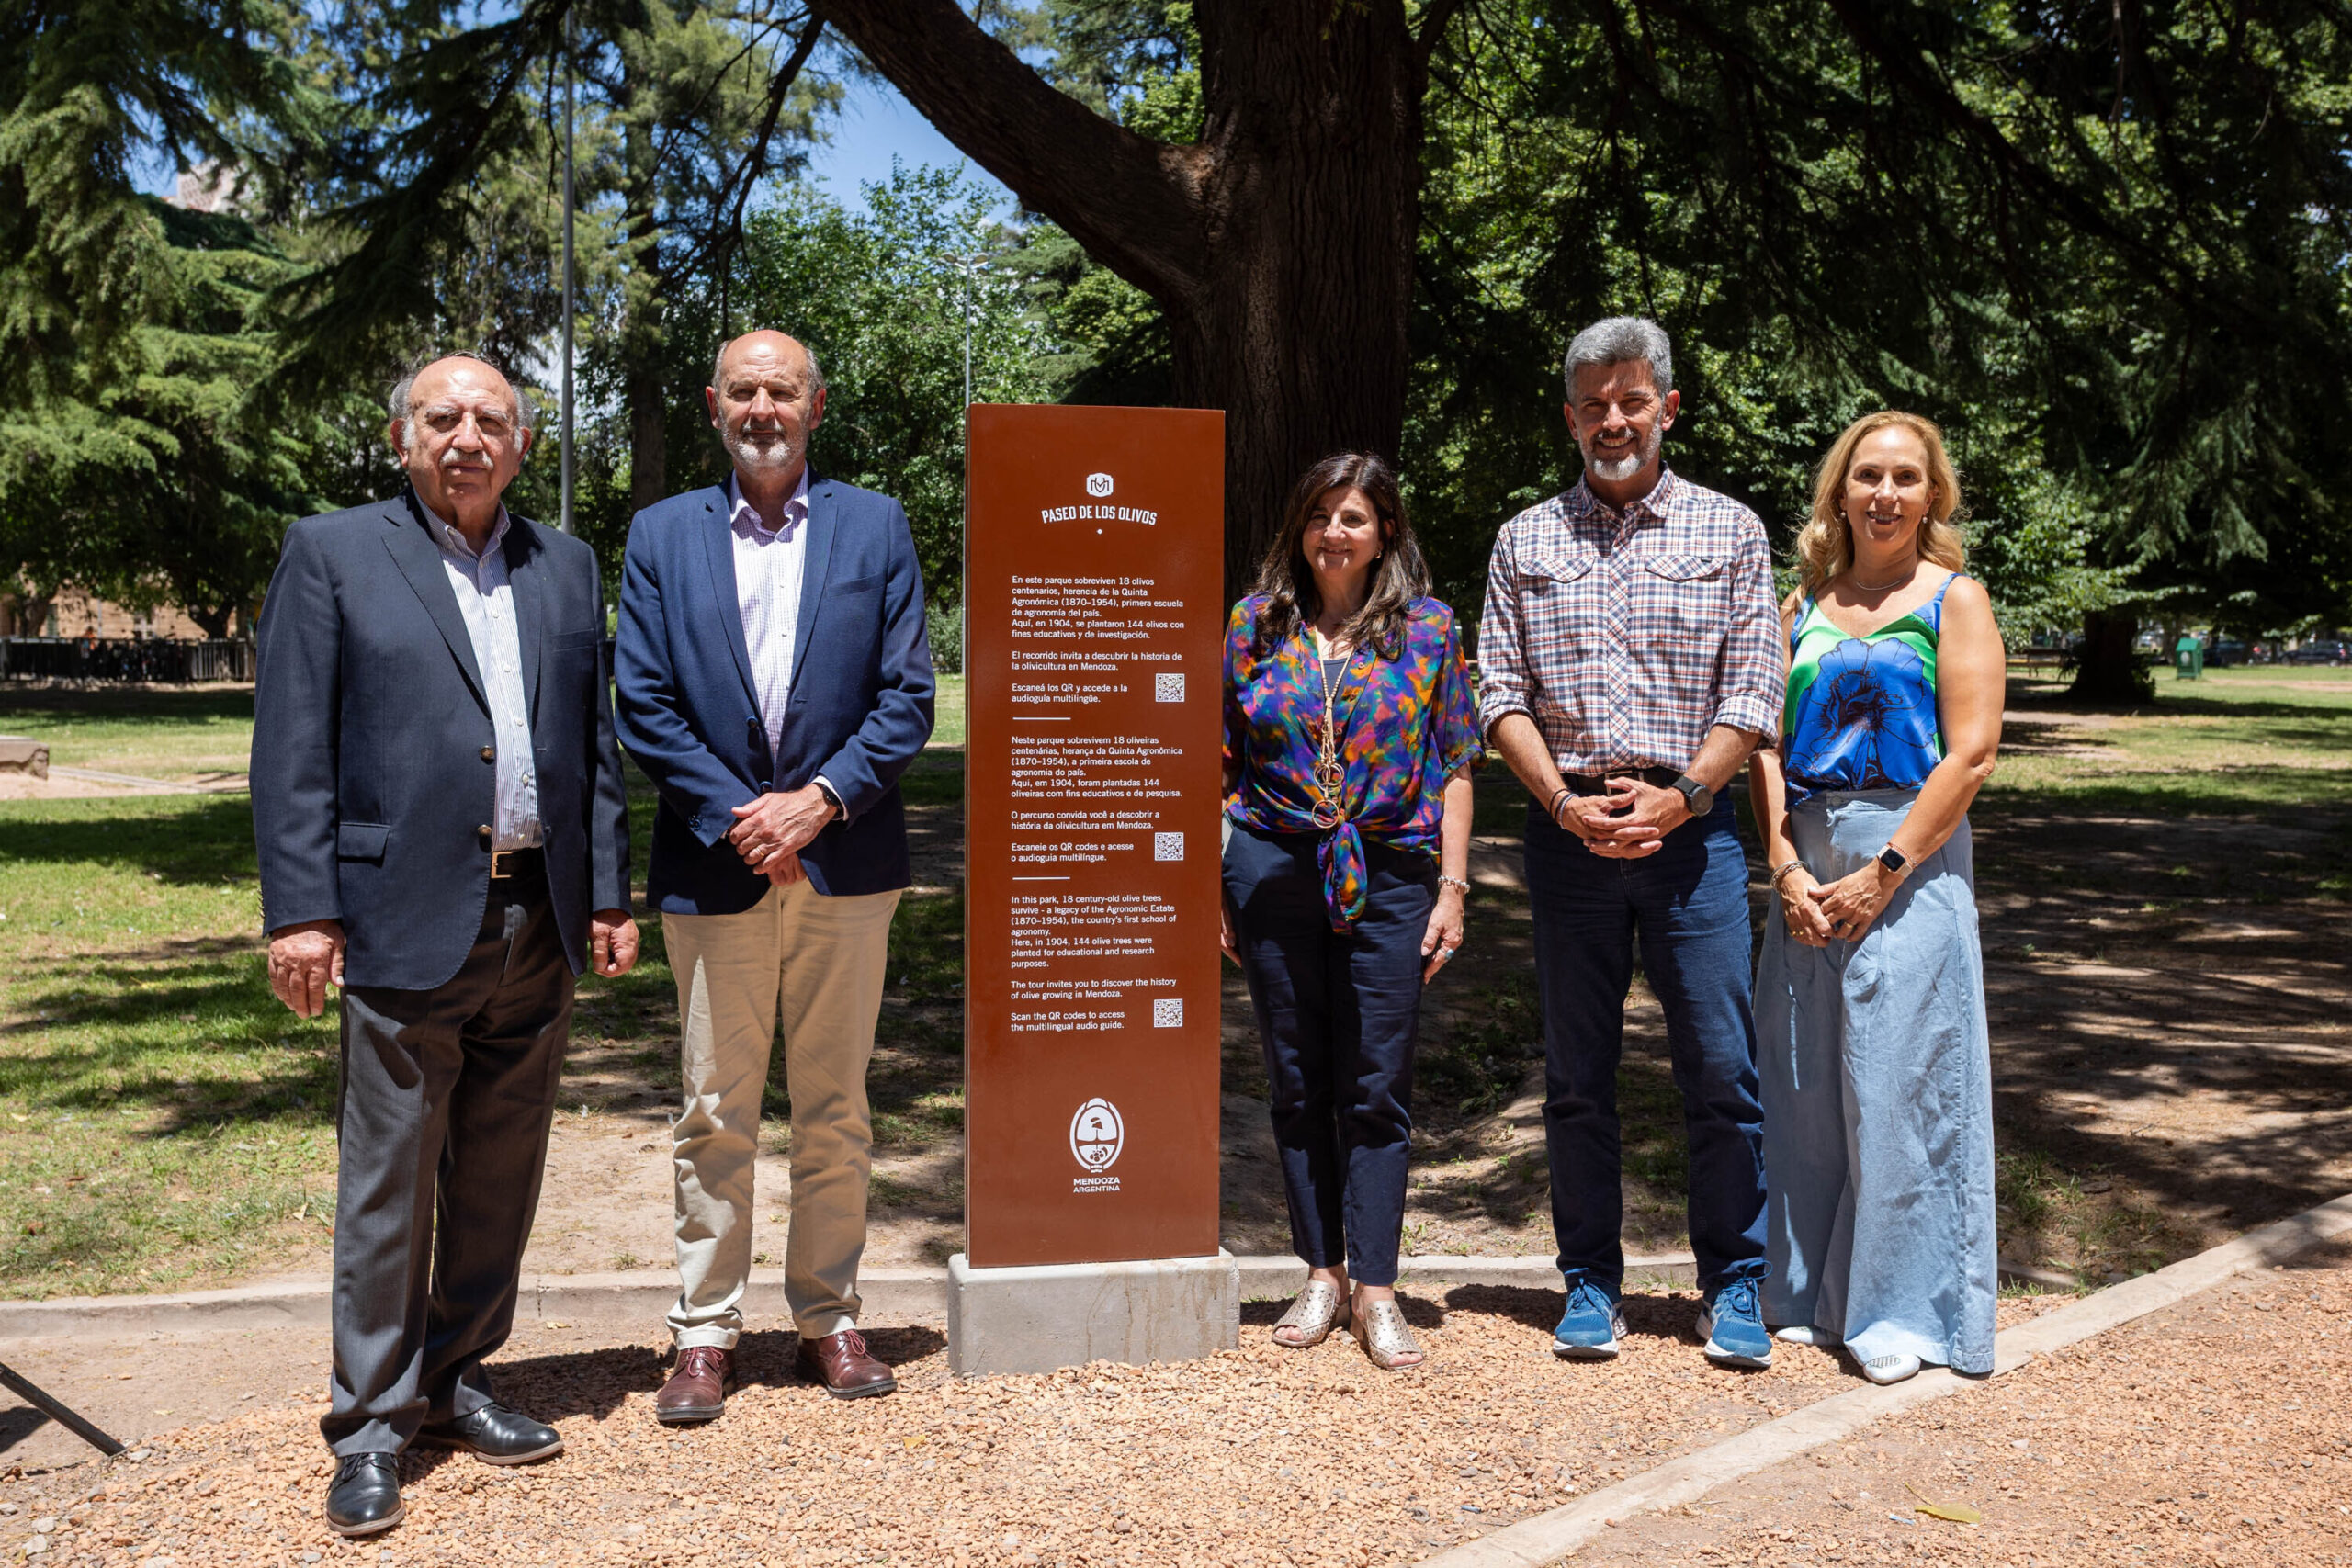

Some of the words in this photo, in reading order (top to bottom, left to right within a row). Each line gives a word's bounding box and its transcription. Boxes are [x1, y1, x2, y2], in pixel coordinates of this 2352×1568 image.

[1042, 506, 1077, 524] PASEO
[1079, 505, 1093, 519] DE
[1095, 505, 1116, 519] LOS
[1118, 507, 1158, 525] OLIVOS
[1012, 575, 1023, 583] En
[1044, 577, 1072, 585] parque
[1119, 577, 1130, 585] 18
[1131, 577, 1154, 585] olivos
[1012, 587, 1060, 595] centenarios,
[1063, 587, 1097, 595] herencia
[1099, 587, 1109, 595] de
[1112, 587, 1119, 595] la
[1121, 587, 1148, 596] Quinta
[1012, 597, 1058, 606] Agronómica
[1121, 599, 1151, 607] primera
[1153, 599, 1183, 607] escuela
[1023, 608, 1066, 617] agronomía
[1068, 608, 1080, 616] del
[1082, 609, 1102, 617] país.
[1087, 619, 1125, 628] plantaron
[1127, 619, 1143, 627] 144
[1145, 620, 1168, 628] olivos
[1012, 629, 1031, 637] fines
[1033, 629, 1076, 637] educativos
[1097, 630, 1150, 639] investigación.
[1012, 650, 1020, 659] El
[1091, 651, 1129, 660] descubrir
[1012, 661, 1019, 670] la
[1021, 661, 1066, 670] olivicultura
[1047, 683, 1059, 692] los
[1060, 683, 1073, 692] QR
[1082, 683, 1111, 692] accede
[1120, 683, 1127, 692] la
[1012, 736, 1035, 744] Neste
[1067, 736, 1111, 744] sobrevivem
[1114, 736, 1125, 744] 18
[1126, 736, 1159, 744] oliveiras
[1011, 747, 1059, 755] centenárias,
[1062, 747, 1093, 756] herança
[1108, 746, 1135, 754] Quinta
[1136, 746, 1182, 756] Agronômica
[1079, 757, 1112, 766] primeira
[1114, 757, 1138, 765] escola
[1140, 757, 1151, 765] de
[1011, 768, 1053, 777] agronomia
[1067, 768, 1086, 777] país.
[1077, 778, 1100, 786] foram
[1102, 778, 1141, 787] plantadas
[1144, 778, 1159, 786] 144
[1011, 789, 1045, 797] oliveiras
[1146, 788, 1182, 798] pesquisa.
[1020, 812, 1055, 820] percurso
[1056, 810, 1087, 818] convida
[1089, 810, 1107, 818] você
[1011, 821, 1041, 829] história
[1043, 821, 1053, 829] da
[1055, 821, 1100, 829] olivicultura
[1116, 820, 1154, 829] Mendoza.
[1060, 842, 1072, 851] QR
[1074, 842, 1099, 851] codes
[1039, 896, 1058, 905] park,
[1063, 895, 1073, 903] 18
[1075, 895, 1120, 904] century-old
[1122, 894, 1140, 902] olive
[1142, 894, 1161, 902] trees
[1011, 906, 1039, 914] survive
[1054, 906, 1079, 915] legacy
[1080, 905, 1089, 913] of
[1106, 905, 1148, 914] Agronomic
[1150, 904, 1174, 912] Estate
[1070, 916, 1084, 924] the
[1124, 915, 1139, 923] first
[1168, 914, 1176, 922] of
[1011, 929, 1051, 937] agronomy.
[1011, 938, 1032, 946] Here,
[1074, 937, 1090, 945] 144
[1011, 948, 1041, 958] planted
[1043, 948, 1055, 956] for
[1056, 947, 1102, 956] educational
[1104, 947, 1119, 955] and
[1122, 946, 1154, 954] research
[1011, 960, 1049, 969] purposes.
[1011, 980, 1026, 988] The
[1150, 977, 1176, 987] history
[1011, 991, 1019, 999] of
[1021, 991, 1040, 999] olive
[1042, 990, 1073, 1000] growing
[1085, 989, 1122, 998] Mendoza.
[1011, 1012, 1031, 1021] Scan
[1048, 1011, 1060, 1020] QR
[1063, 1011, 1086, 1020] codes
[1026, 1022, 1073, 1032] multilingual
[1075, 1021, 1098, 1030] audio
[1100, 1021, 1124, 1031] guide.
[1073, 1177, 1120, 1185] MENDOZA
